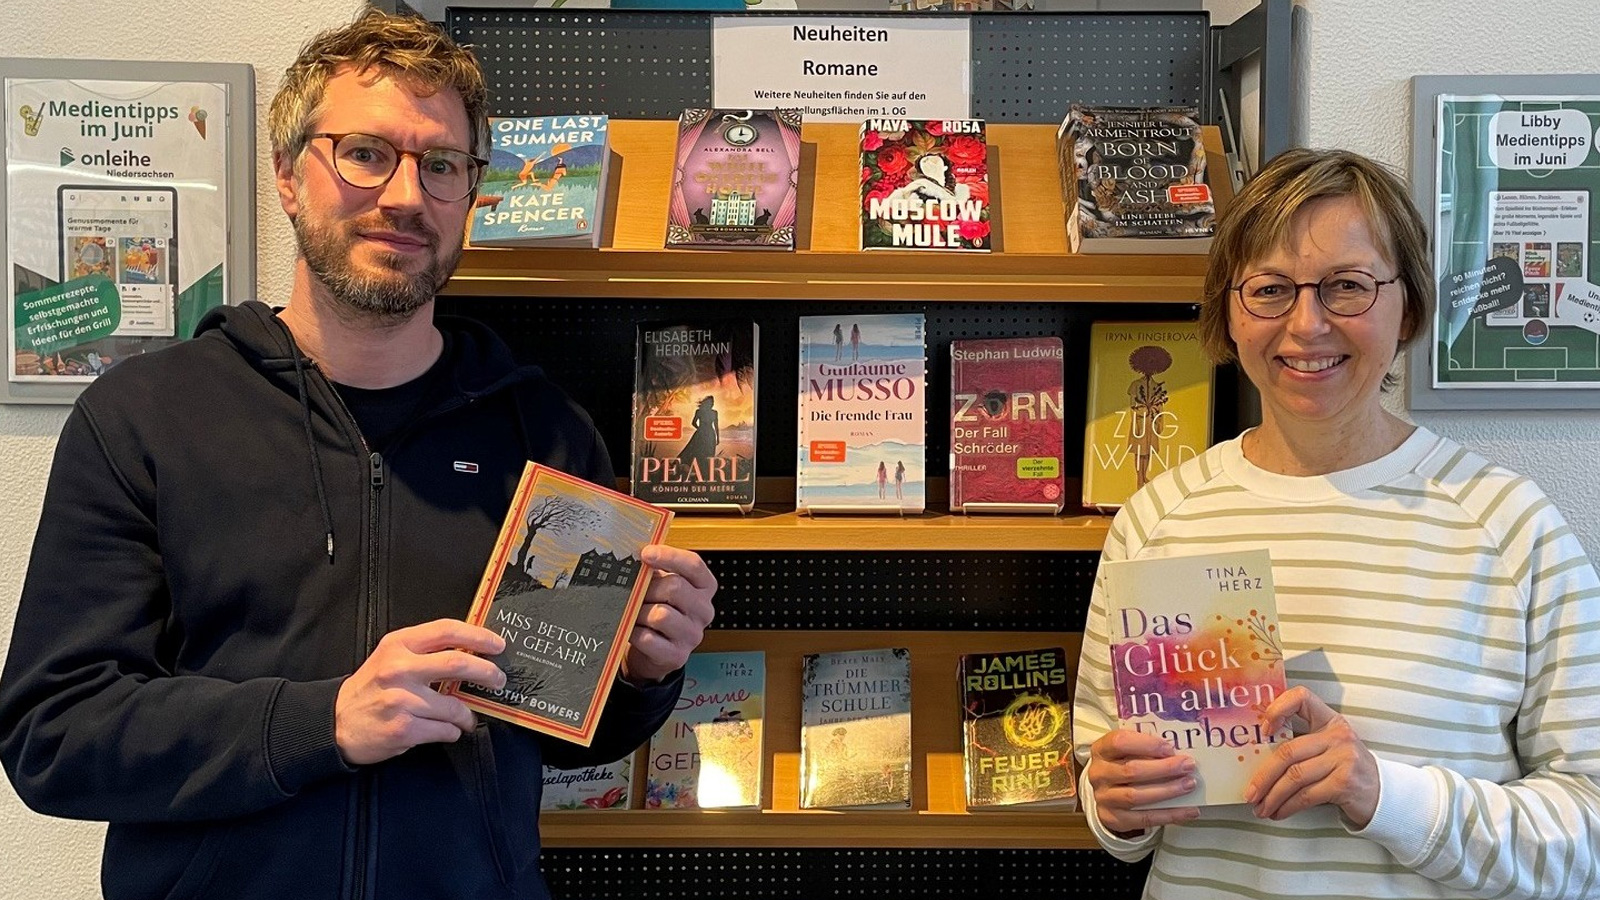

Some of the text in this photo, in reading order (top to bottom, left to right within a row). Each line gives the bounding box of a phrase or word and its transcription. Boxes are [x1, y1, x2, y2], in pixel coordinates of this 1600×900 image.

[793, 25, 888, 42] Neuheiten
[803, 60, 878, 76] Romane
[754, 90, 926, 100] Weitere Neuheiten finden Sie auf den
[49, 101, 179, 124] Medientipps
[867, 107, 878, 115] im
[881, 107, 890, 115] 1.
[892, 107, 906, 115] OG
[81, 120, 153, 141] im Juni
[498, 116, 602, 132] ONE LAST
[870, 119, 981, 133] MAYA ROSA
[1521, 114, 1561, 131] Libby
[501, 131, 594, 147] SUMMER
[1084, 128, 1193, 138] ARMENTROUT
[1496, 133, 1586, 150] Medientipps
[81, 150, 151, 166] onleihe
[1103, 142, 1177, 157] BORN
[1513, 152, 1567, 165] im Juni
[107, 170, 174, 178] Niedersachsen
[1098, 165, 1188, 180] BLOOD
[509, 193, 564, 208] KATE
[1119, 190, 1169, 204] ASH
[484, 207, 585, 226] SPENCER
[869, 198, 983, 222] MOSCOW
[1131, 218, 1183, 227] SCHATTEN
[892, 223, 961, 247] MULE
[1453, 263, 1497, 284] 90 Minuten
[1450, 272, 1506, 297] reichen nicht?
[23, 284, 98, 311] Sommerrezepte,
[1452, 284, 1512, 308] Entdecke mehr
[1588, 290, 1600, 301] Un
[29, 296, 99, 322] selbstgemachte
[1467, 299, 1500, 315] Fußball!
[27, 306, 109, 336] Erfrischungen und
[32, 318, 112, 347] Ideen für den Grill
[645, 330, 711, 344] ELISABETH
[1105, 332, 1198, 341] IRYNA FINGEROVA
[655, 342, 730, 356] HERRMANN
[954, 346, 1064, 362] Stephan Ludwig
[818, 363, 906, 377] Guillaume
[809, 377, 916, 402] MUSSO
[810, 410, 913, 422] Die fremde Frau
[955, 427, 1008, 439] Der Fall
[1113, 411, 1179, 439] ZUG
[954, 442, 1019, 454] Schröder
[1093, 443, 1197, 472] WIND
[640, 456, 750, 483] PEARL
[652, 484, 689, 493] KÖNIGIN
[1206, 566, 1248, 580] TINA
[1219, 578, 1262, 592] HERZ
[496, 608, 604, 653] MISS BETONY
[1118, 607, 1193, 639] Das
[500, 626, 589, 667] IN GEFAHR
[973, 652, 1056, 674] JAMES
[1124, 637, 1243, 677] Glück
[846, 668, 868, 679] DIE
[966, 668, 1066, 692] ROLLINS
[812, 679, 900, 697] TRÜMMER
[1129, 677, 1276, 715] in allen
[529, 697, 581, 721] BOWERS
[821, 696, 891, 713] SCHULE
[979, 750, 1060, 775] FEUER
[991, 770, 1051, 793] RING
